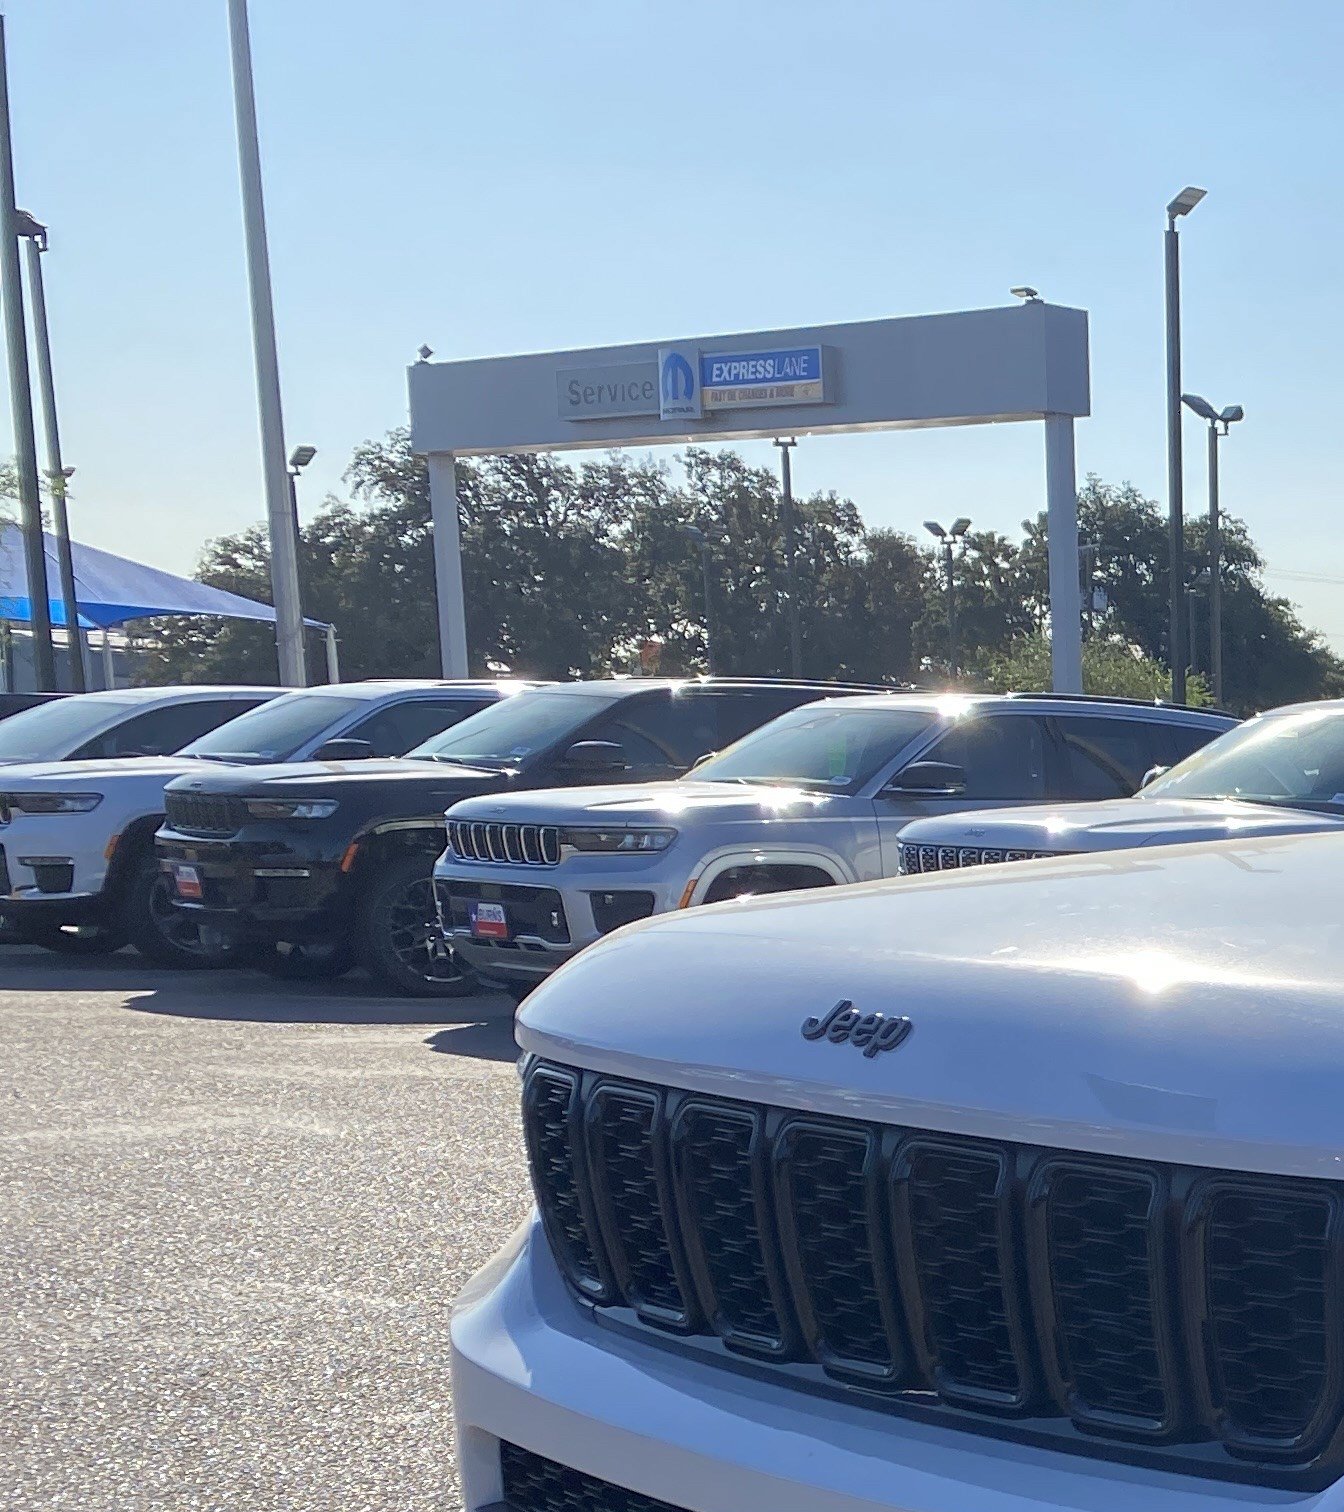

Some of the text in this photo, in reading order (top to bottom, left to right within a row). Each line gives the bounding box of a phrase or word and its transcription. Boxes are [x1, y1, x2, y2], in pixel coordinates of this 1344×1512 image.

[712, 355, 809, 383] EXPRESSLANE
[567, 379, 655, 406] Service
[801, 999, 912, 1058] Jeep
